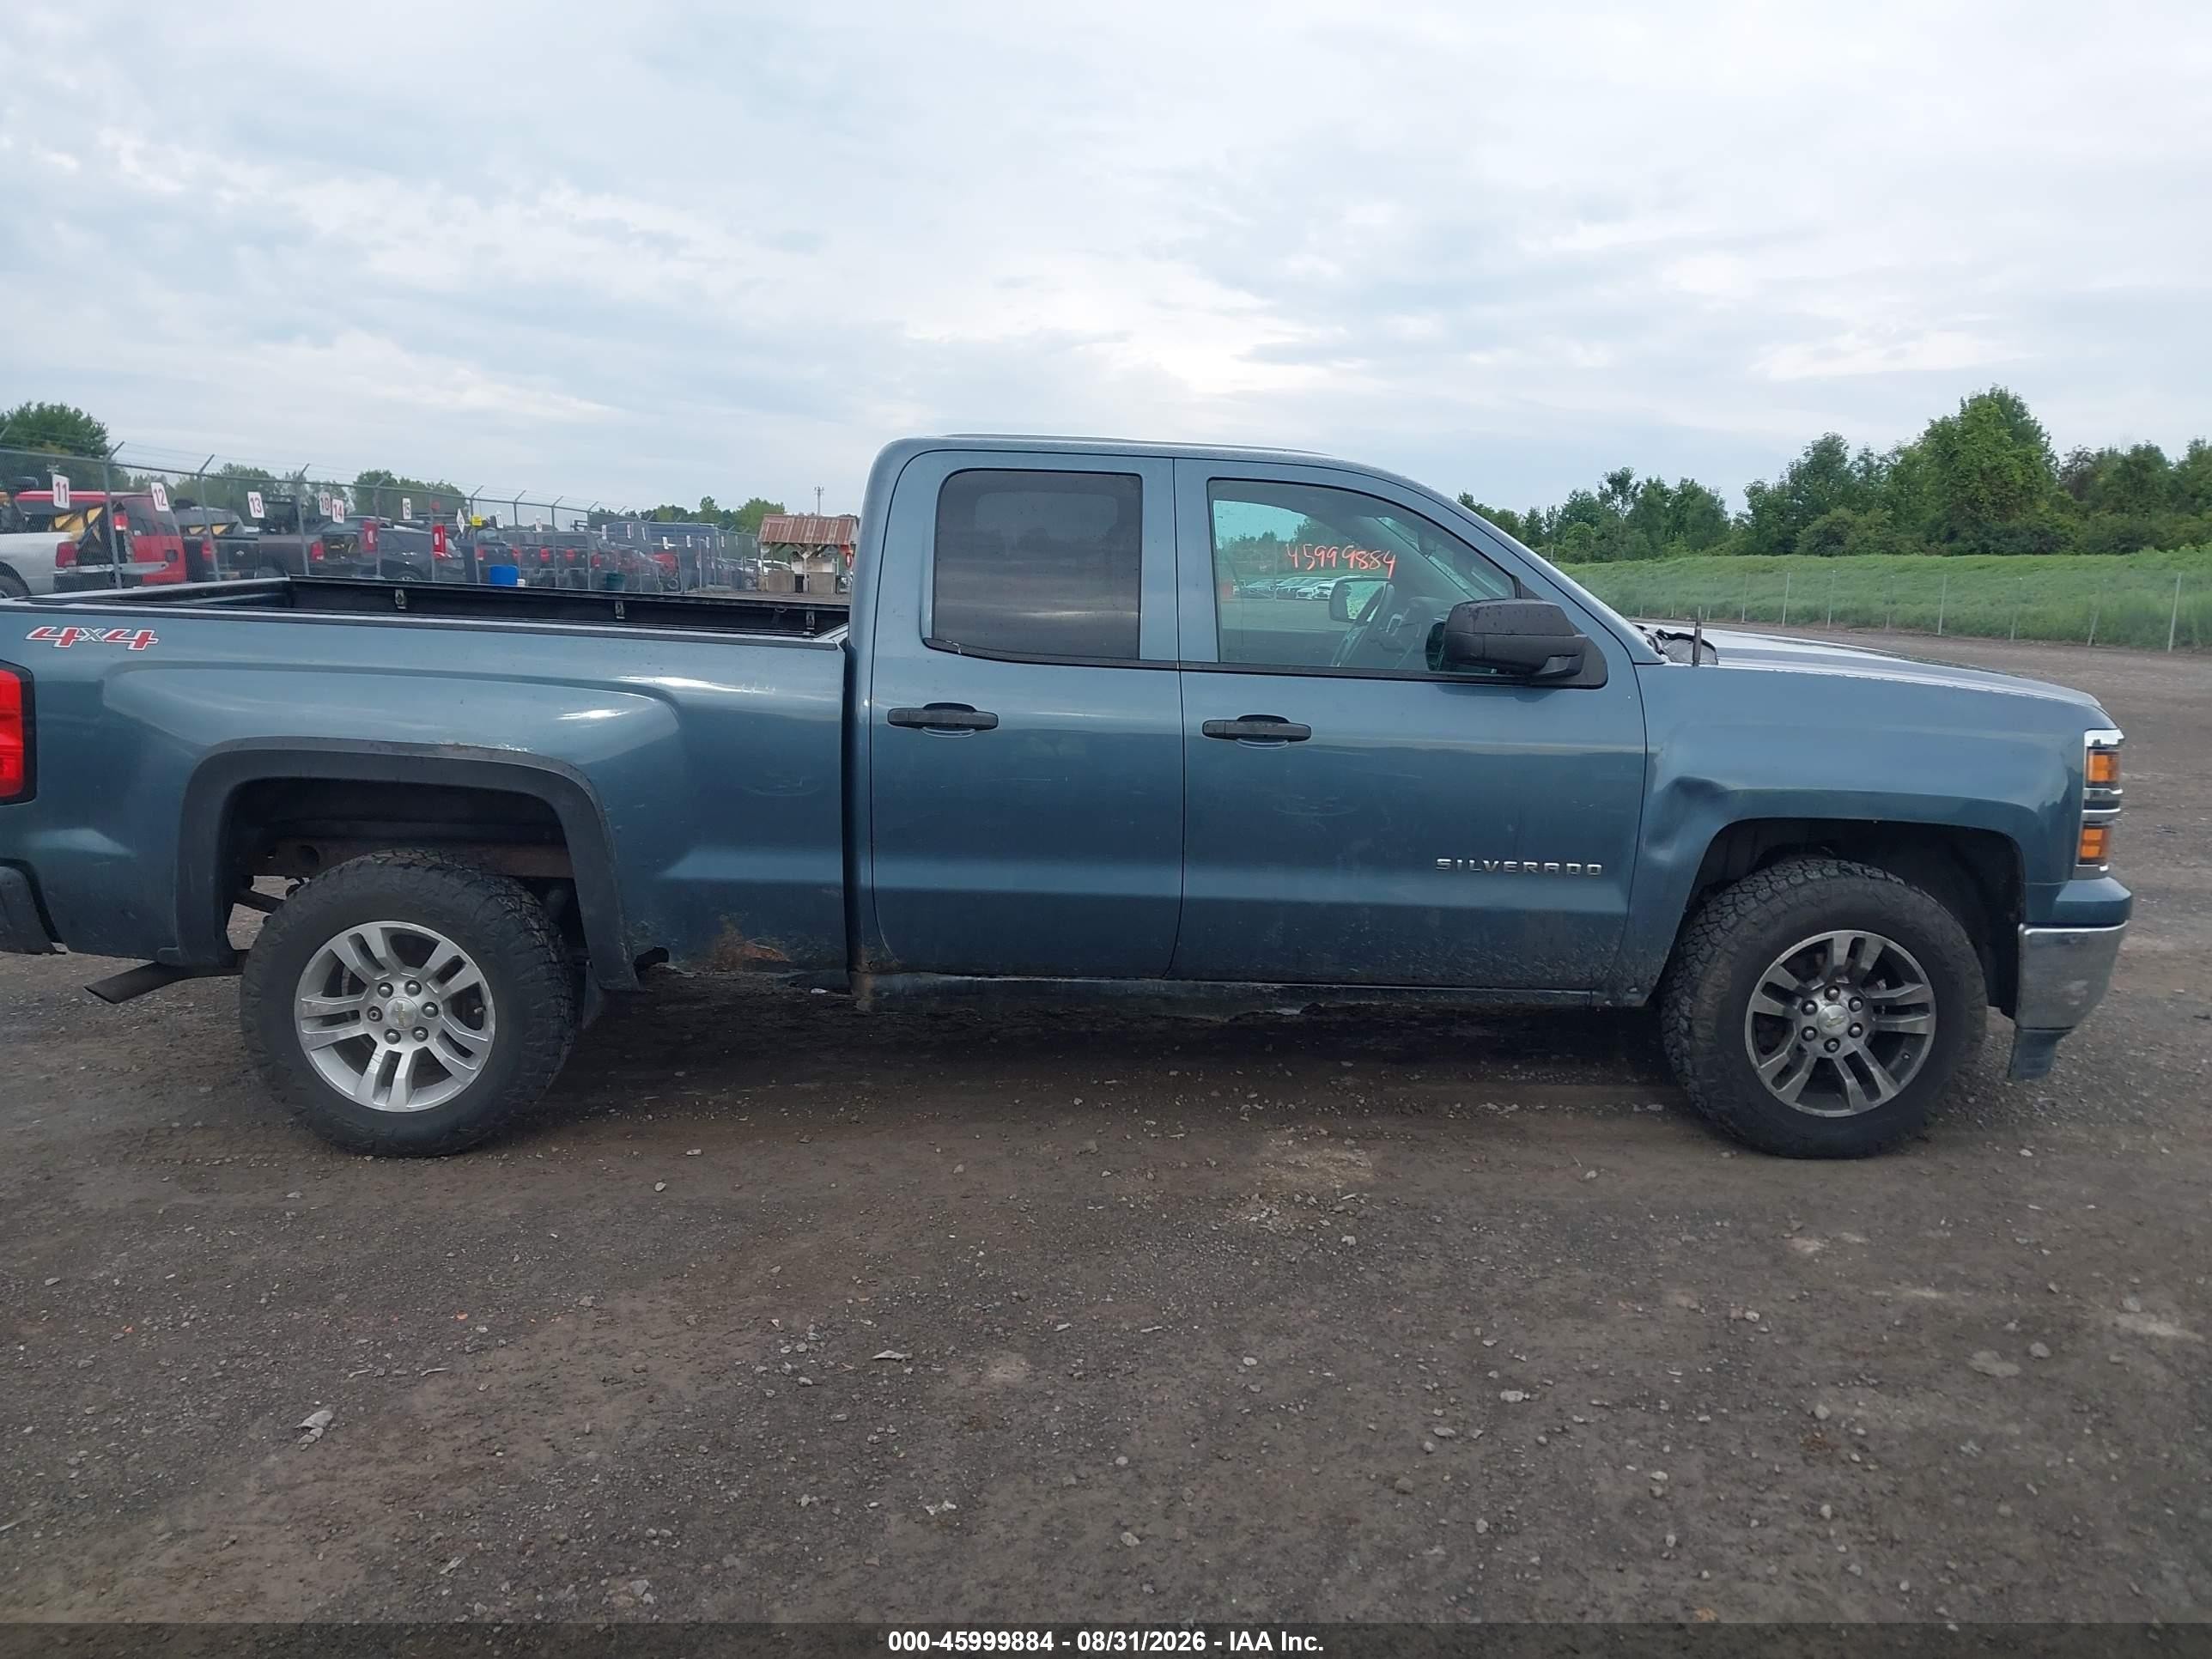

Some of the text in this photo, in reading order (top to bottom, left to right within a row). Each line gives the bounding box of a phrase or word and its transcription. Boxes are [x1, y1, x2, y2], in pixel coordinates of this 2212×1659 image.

[55, 481, 68, 503] 11
[154, 488, 167, 507] 12
[250, 497, 262, 514] 13
[333, 504, 343, 518] 14
[1436, 858, 1602, 876] SILVERADO
